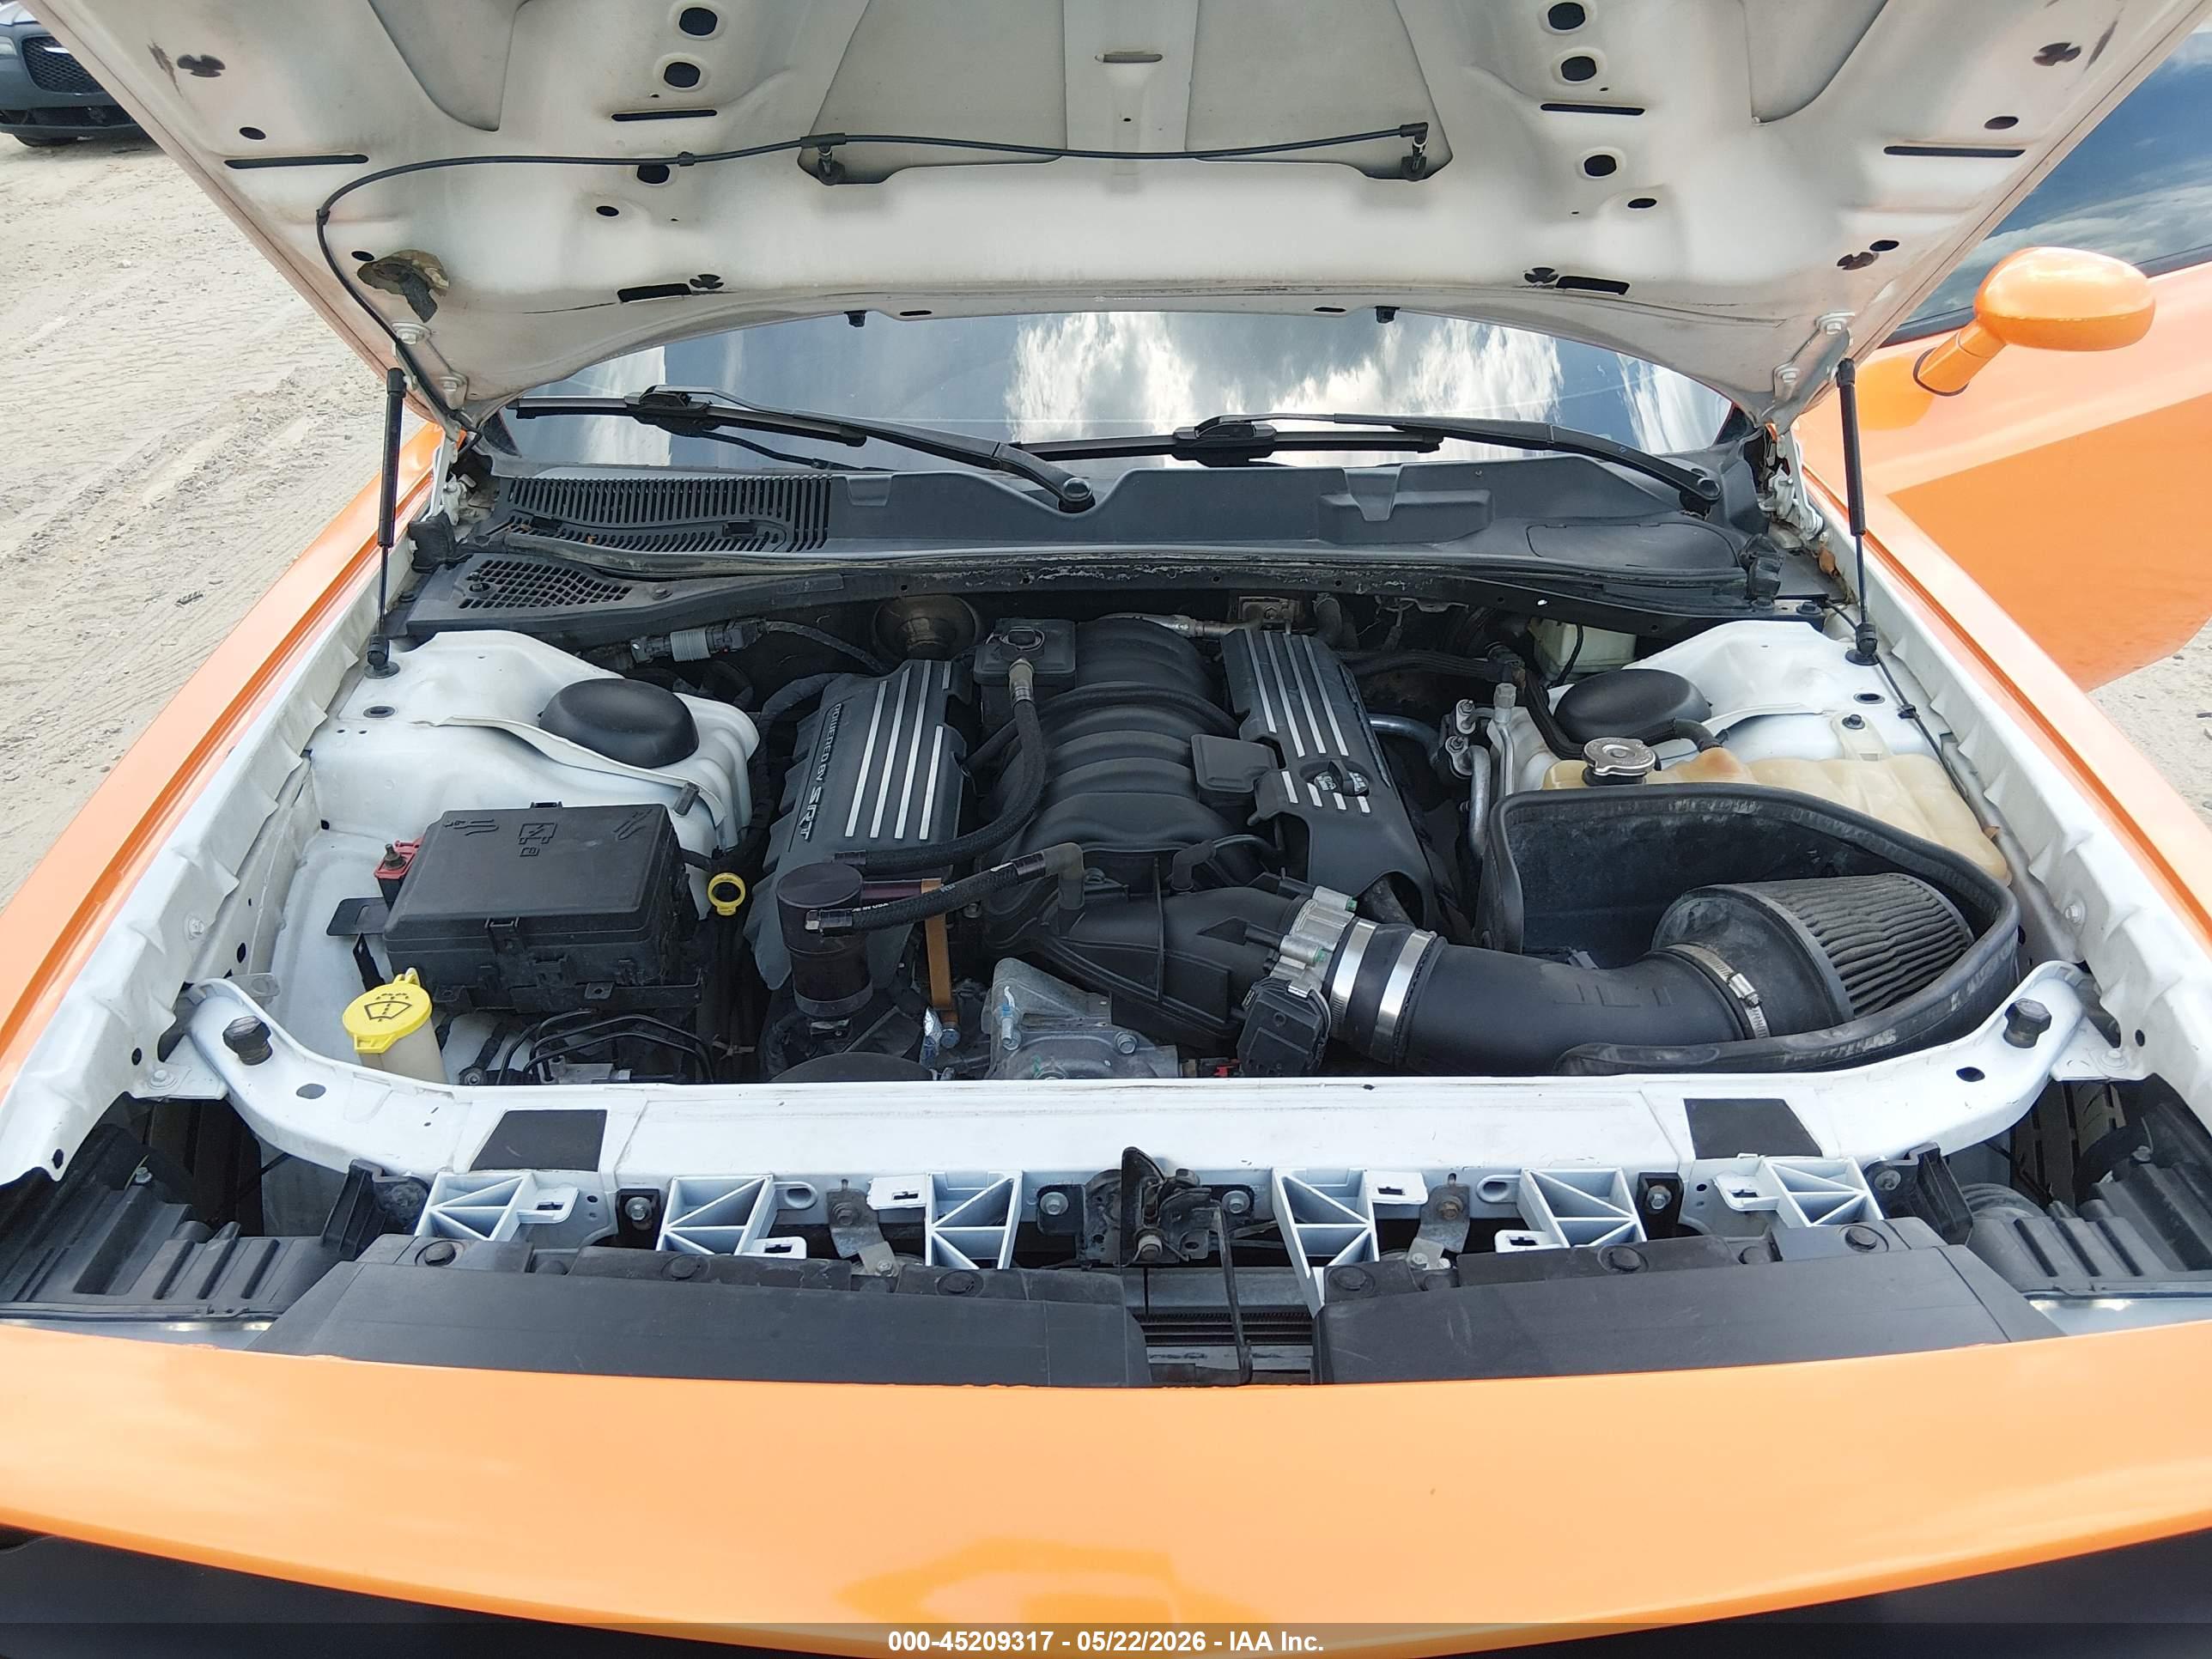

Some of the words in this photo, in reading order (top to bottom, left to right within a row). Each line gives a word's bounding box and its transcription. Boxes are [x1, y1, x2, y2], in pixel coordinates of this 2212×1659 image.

[820, 702, 843, 763] POWERED
[816, 763, 828, 781] BY
[799, 786, 823, 841] SRT
